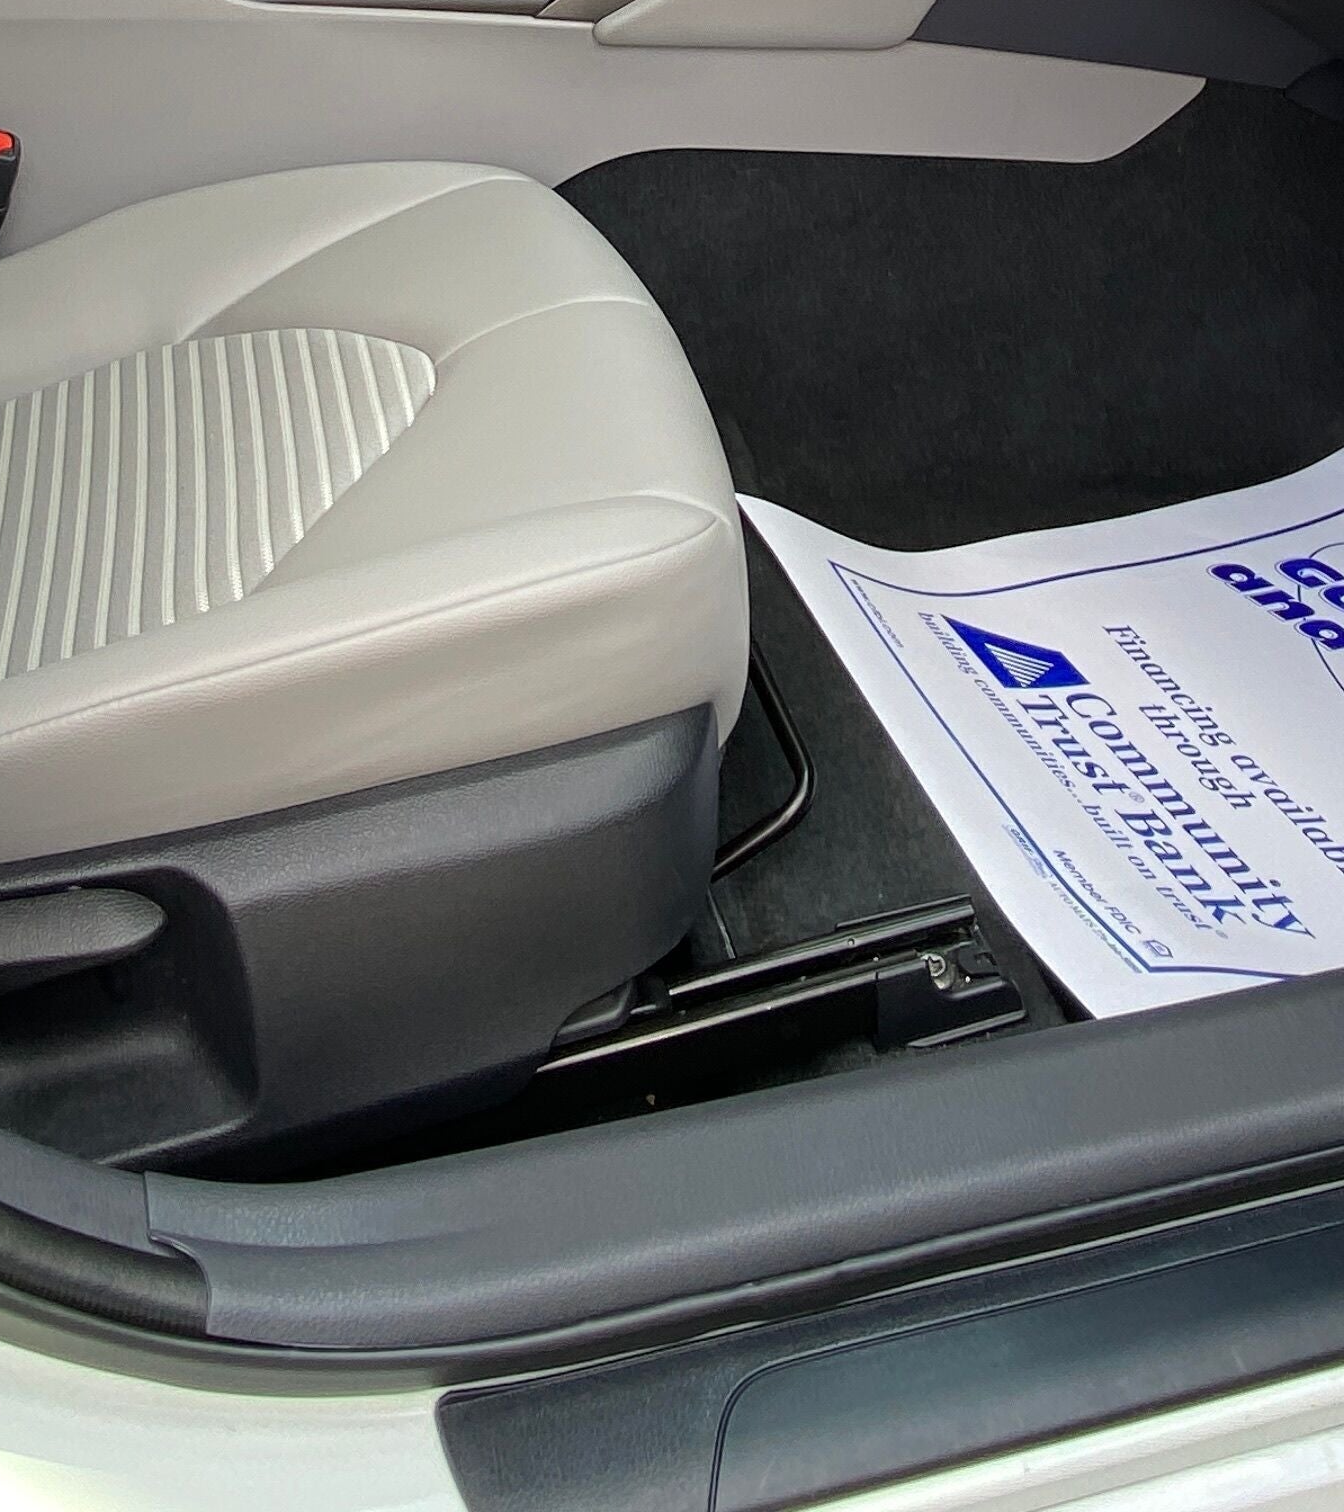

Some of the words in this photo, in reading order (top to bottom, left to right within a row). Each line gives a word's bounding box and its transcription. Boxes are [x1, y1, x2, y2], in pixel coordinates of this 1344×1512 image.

[917, 611, 977, 676] building
[1127, 854, 1157, 881] on
[1102, 625, 1237, 748] Financing
[1064, 691, 1318, 939] Community
[1138, 702, 1258, 811] through
[1052, 849, 1108, 904] Member
[1104, 905, 1143, 935] FDIC
[1114, 808, 1248, 925] Bank
